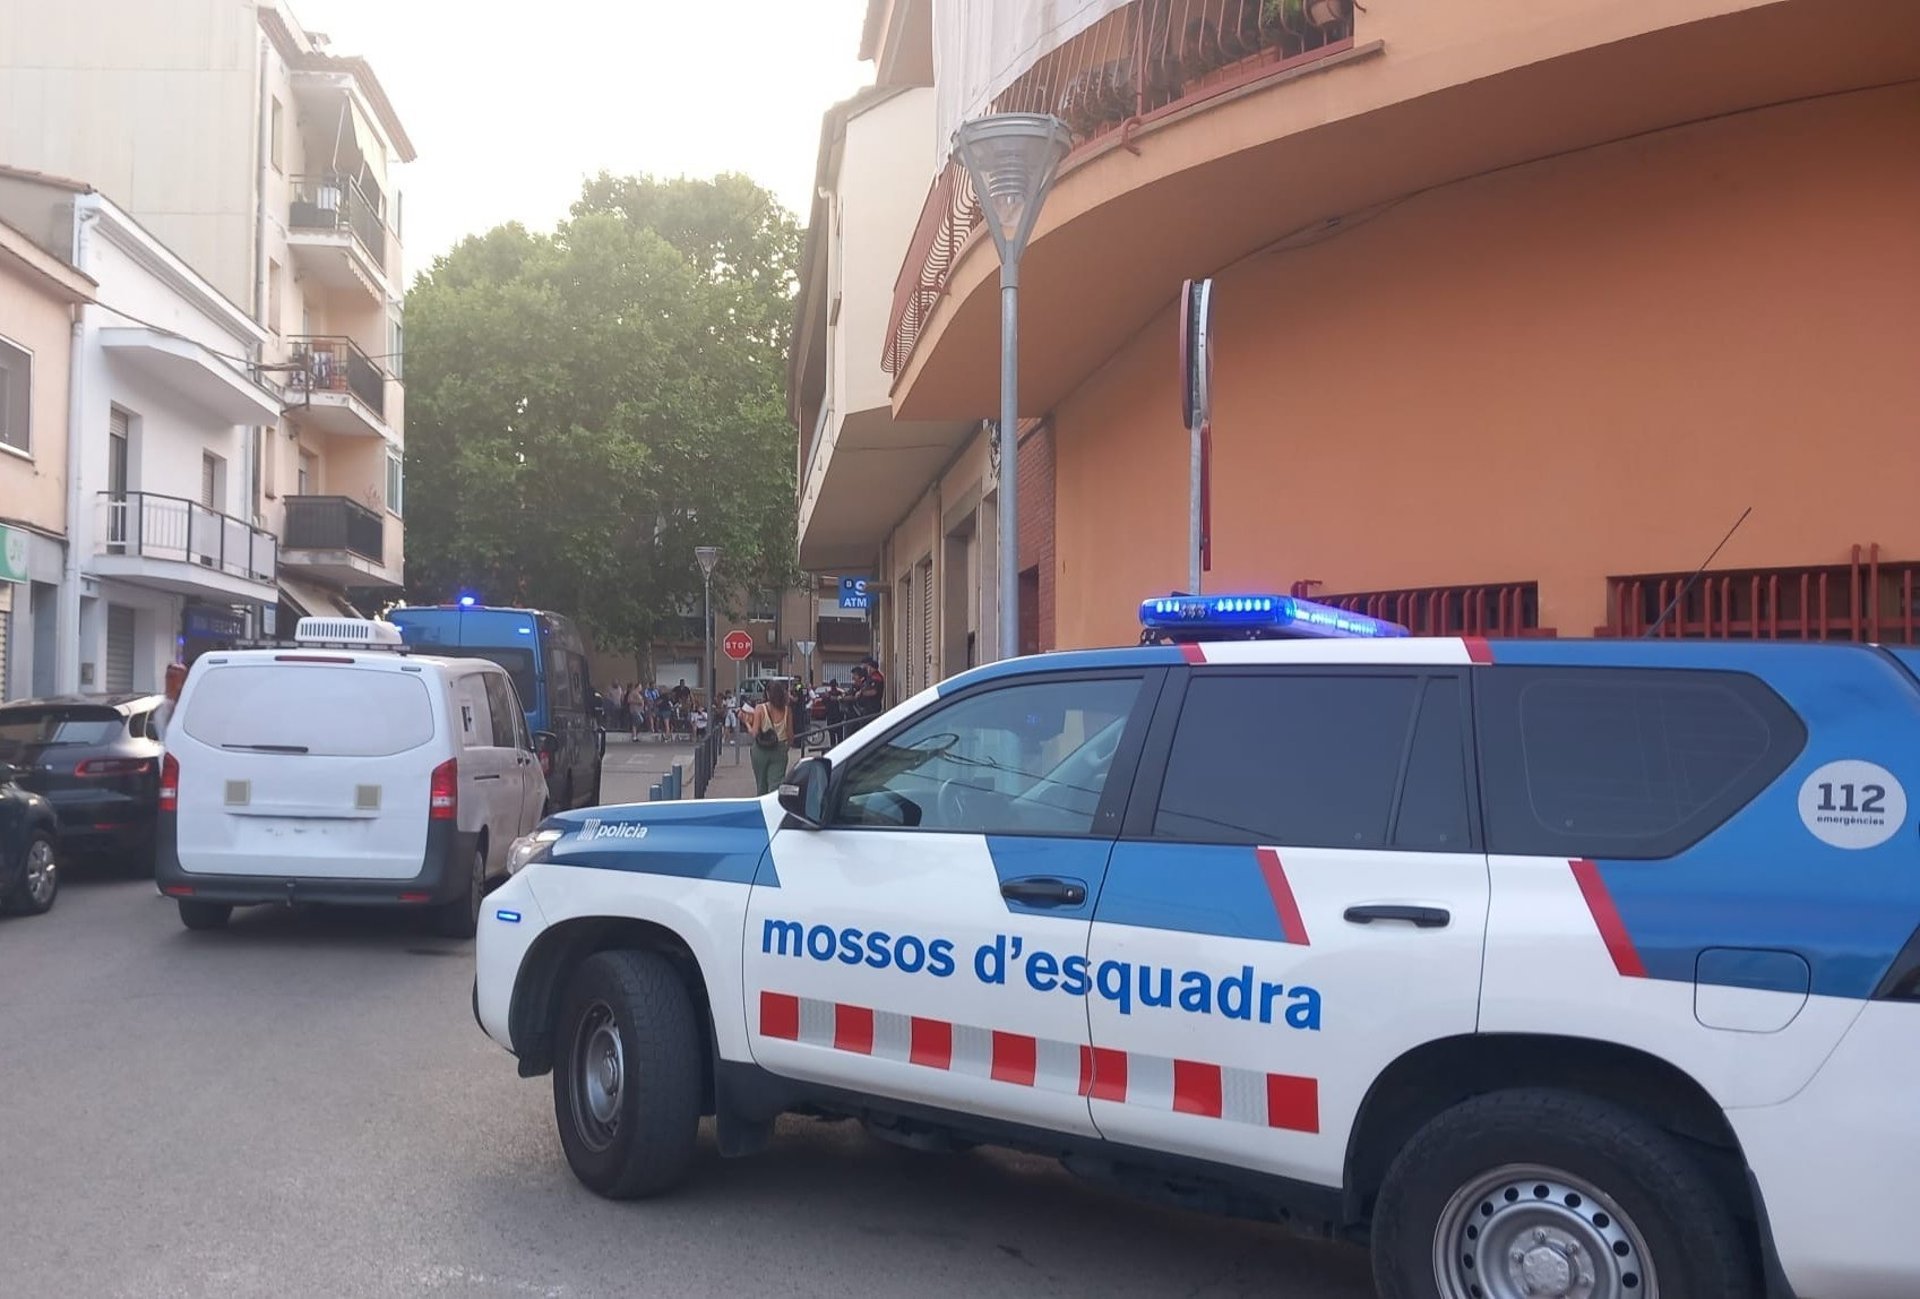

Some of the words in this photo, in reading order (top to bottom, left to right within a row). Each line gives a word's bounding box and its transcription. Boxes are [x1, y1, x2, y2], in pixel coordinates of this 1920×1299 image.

[843, 597, 867, 608] ATM
[725, 641, 751, 649] STOP
[1817, 783, 1886, 813] 112
[594, 821, 648, 839] policia
[761, 918, 956, 978] mossos
